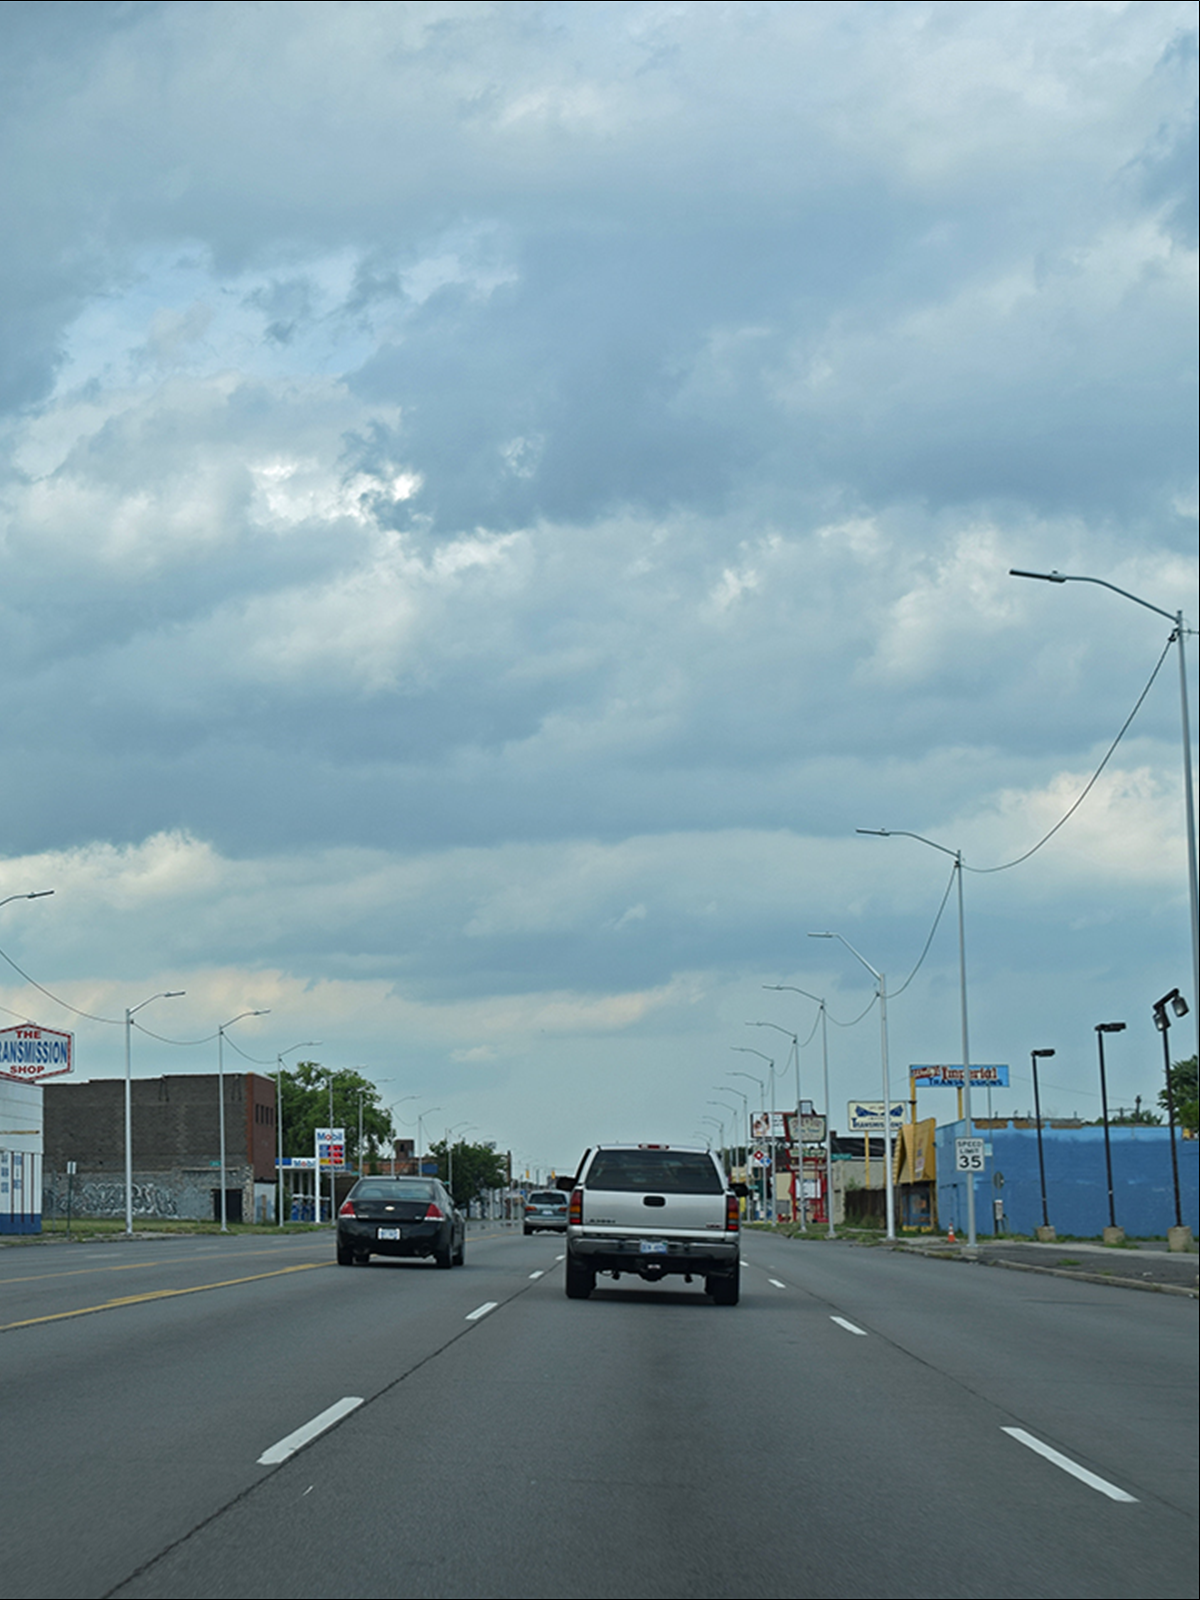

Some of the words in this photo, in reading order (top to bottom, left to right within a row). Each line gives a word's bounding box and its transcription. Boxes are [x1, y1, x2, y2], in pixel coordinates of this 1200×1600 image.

[15, 1030, 42, 1040] THE
[9, 1065, 45, 1075] SHOP
[959, 1155, 982, 1169] 35
